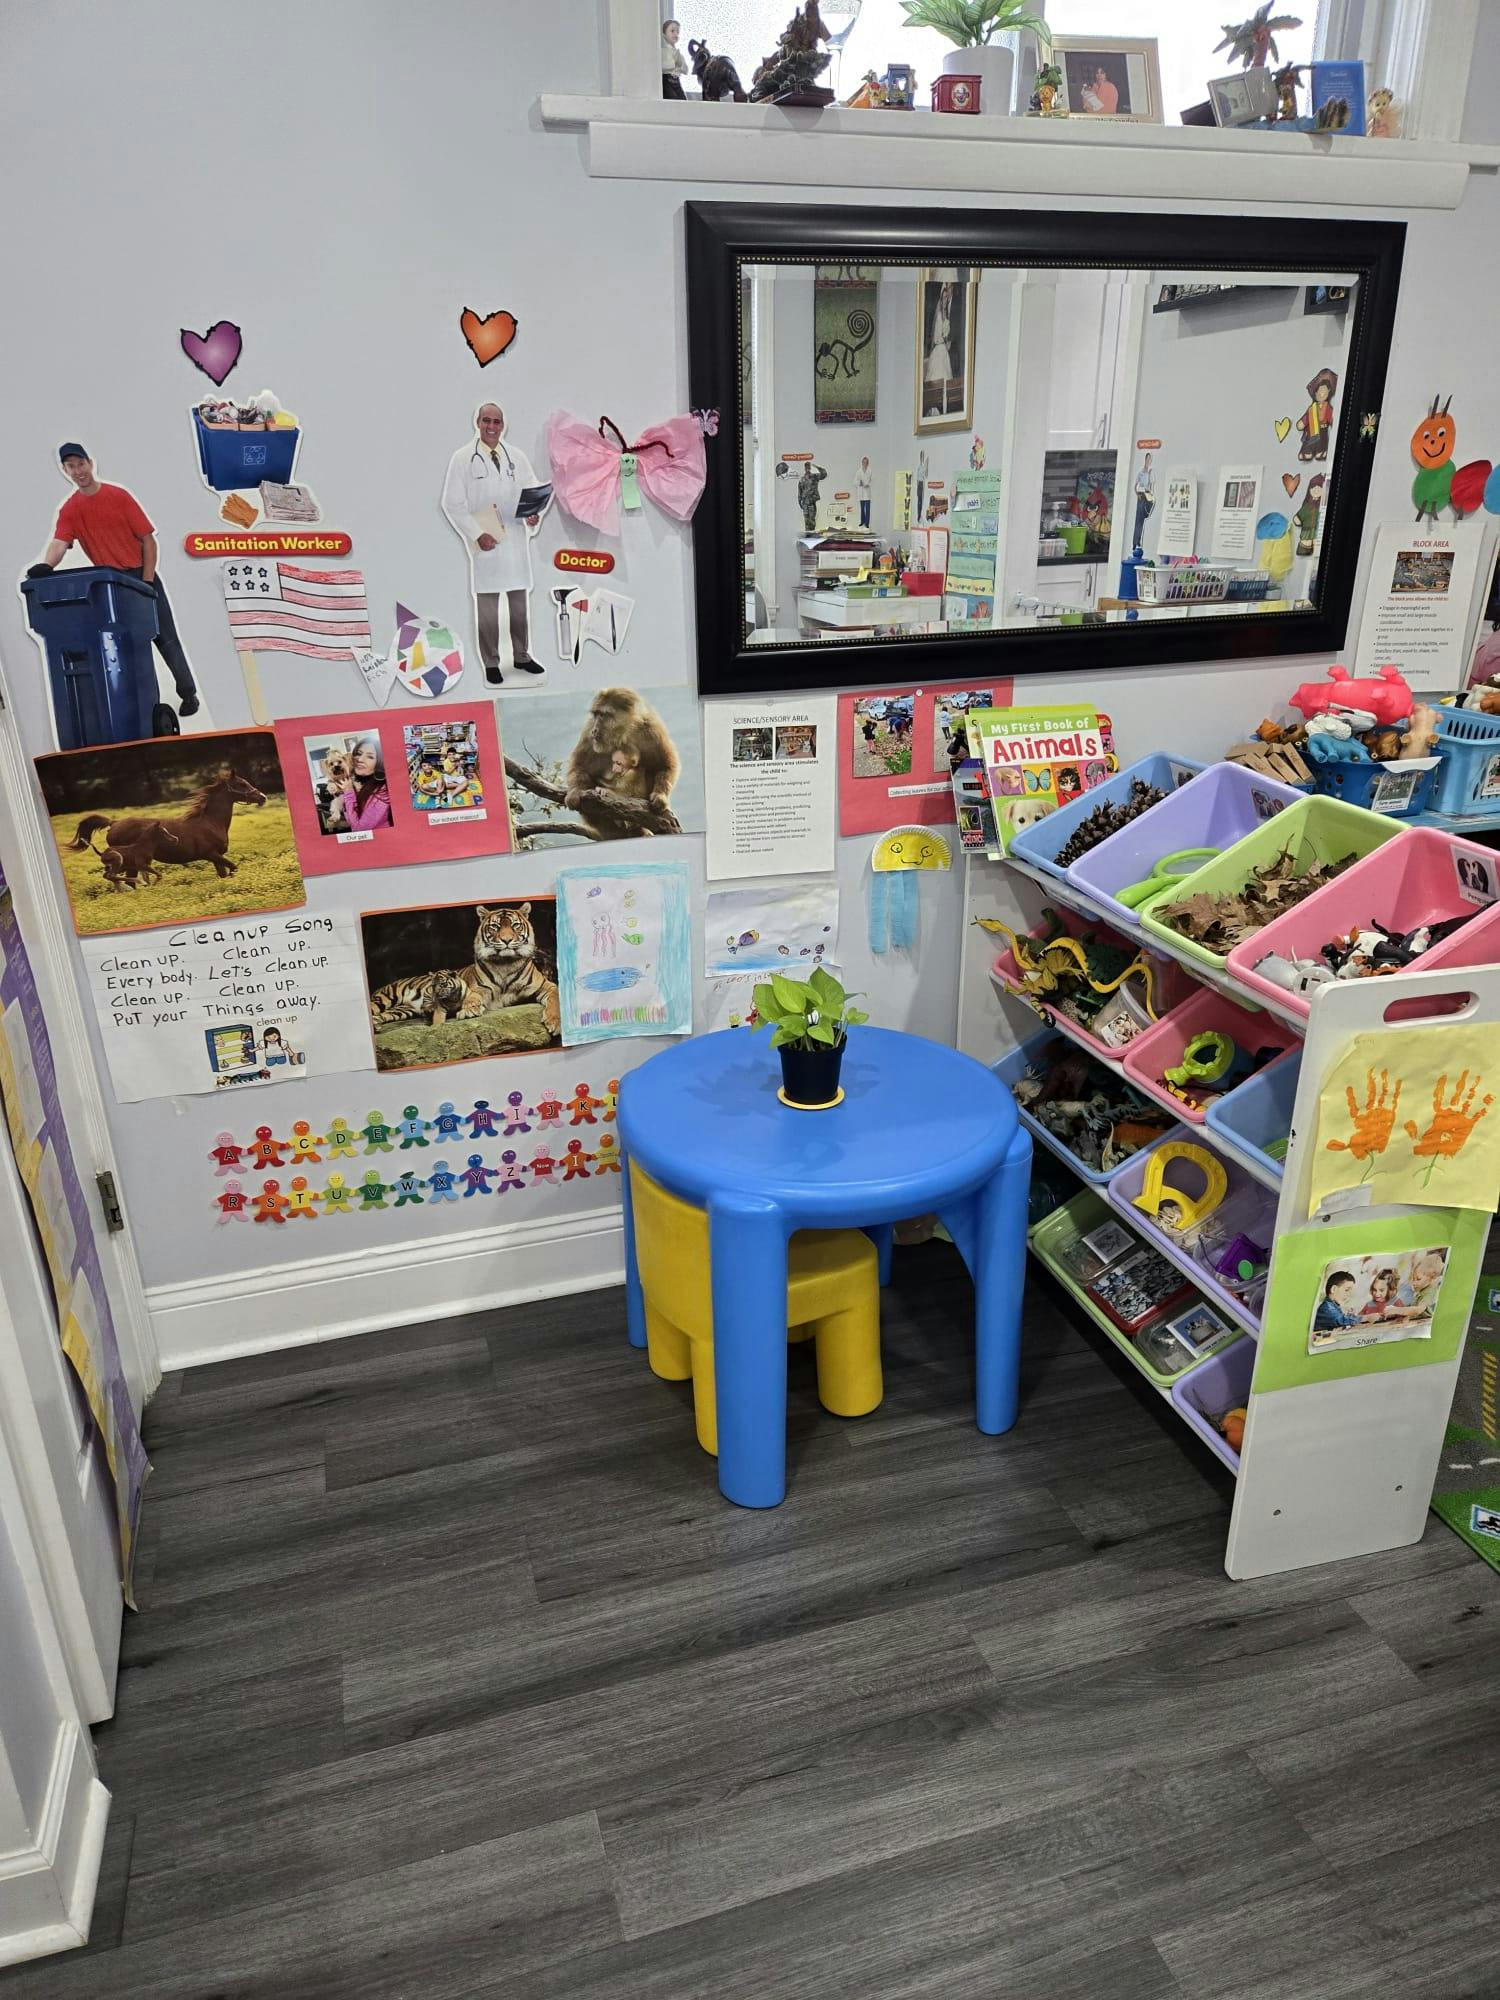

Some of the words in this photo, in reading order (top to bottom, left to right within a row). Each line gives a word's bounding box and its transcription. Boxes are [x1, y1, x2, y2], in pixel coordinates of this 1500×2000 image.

[194, 537, 278, 550] Sanitation
[280, 536, 342, 550] Worker
[1413, 540, 1432, 548] BLOCK
[1432, 540, 1449, 548] AREA
[560, 553, 607, 567] Doctor
[991, 724, 1008, 734] My
[1011, 721, 1040, 733] First
[1044, 719, 1073, 730] Book
[1076, 717, 1089, 729] of
[993, 733, 1097, 764] Animals
[284, 917, 333, 933] Song
[100, 956, 151, 972] Clean
[222, 944, 270, 960] Clean
[107, 976, 154, 990] Every
[111, 992, 157, 1007] Clean
[219, 982, 266, 997] Clean
[153, 1010, 188, 1027] your
[202, 1003, 264, 1017] Things
[276, 995, 321, 1011] away.
[256, 1016, 283, 1027] clean
[285, 1015, 298, 1025] up
[225, 1150, 233, 1160] A
[263, 1145, 272, 1154] B
[299, 1139, 309, 1149] C
[337, 1133, 346, 1144] D
[374, 1128, 382, 1138] E
[410, 1123, 418, 1133] F
[443, 1119, 453, 1128] G
[479, 1113, 488, 1124] H
[514, 1108, 520, 1120] I
[548, 1105, 554, 1116] J
[580, 1101, 588, 1111] K
[230, 1196, 238, 1207] R
[267, 1198, 275, 1208] S
[296, 1194, 304, 1204] T
[332, 1190, 342, 1200] U
[368, 1187, 378, 1197] V
[401, 1180, 414, 1191] W
[437, 1176, 447, 1188] X
[472, 1171, 481, 1183] Y
[507, 1167, 515, 1177] Z
[572, 1155, 579, 1167] I
[1355, 1338, 1378, 1346] Share
